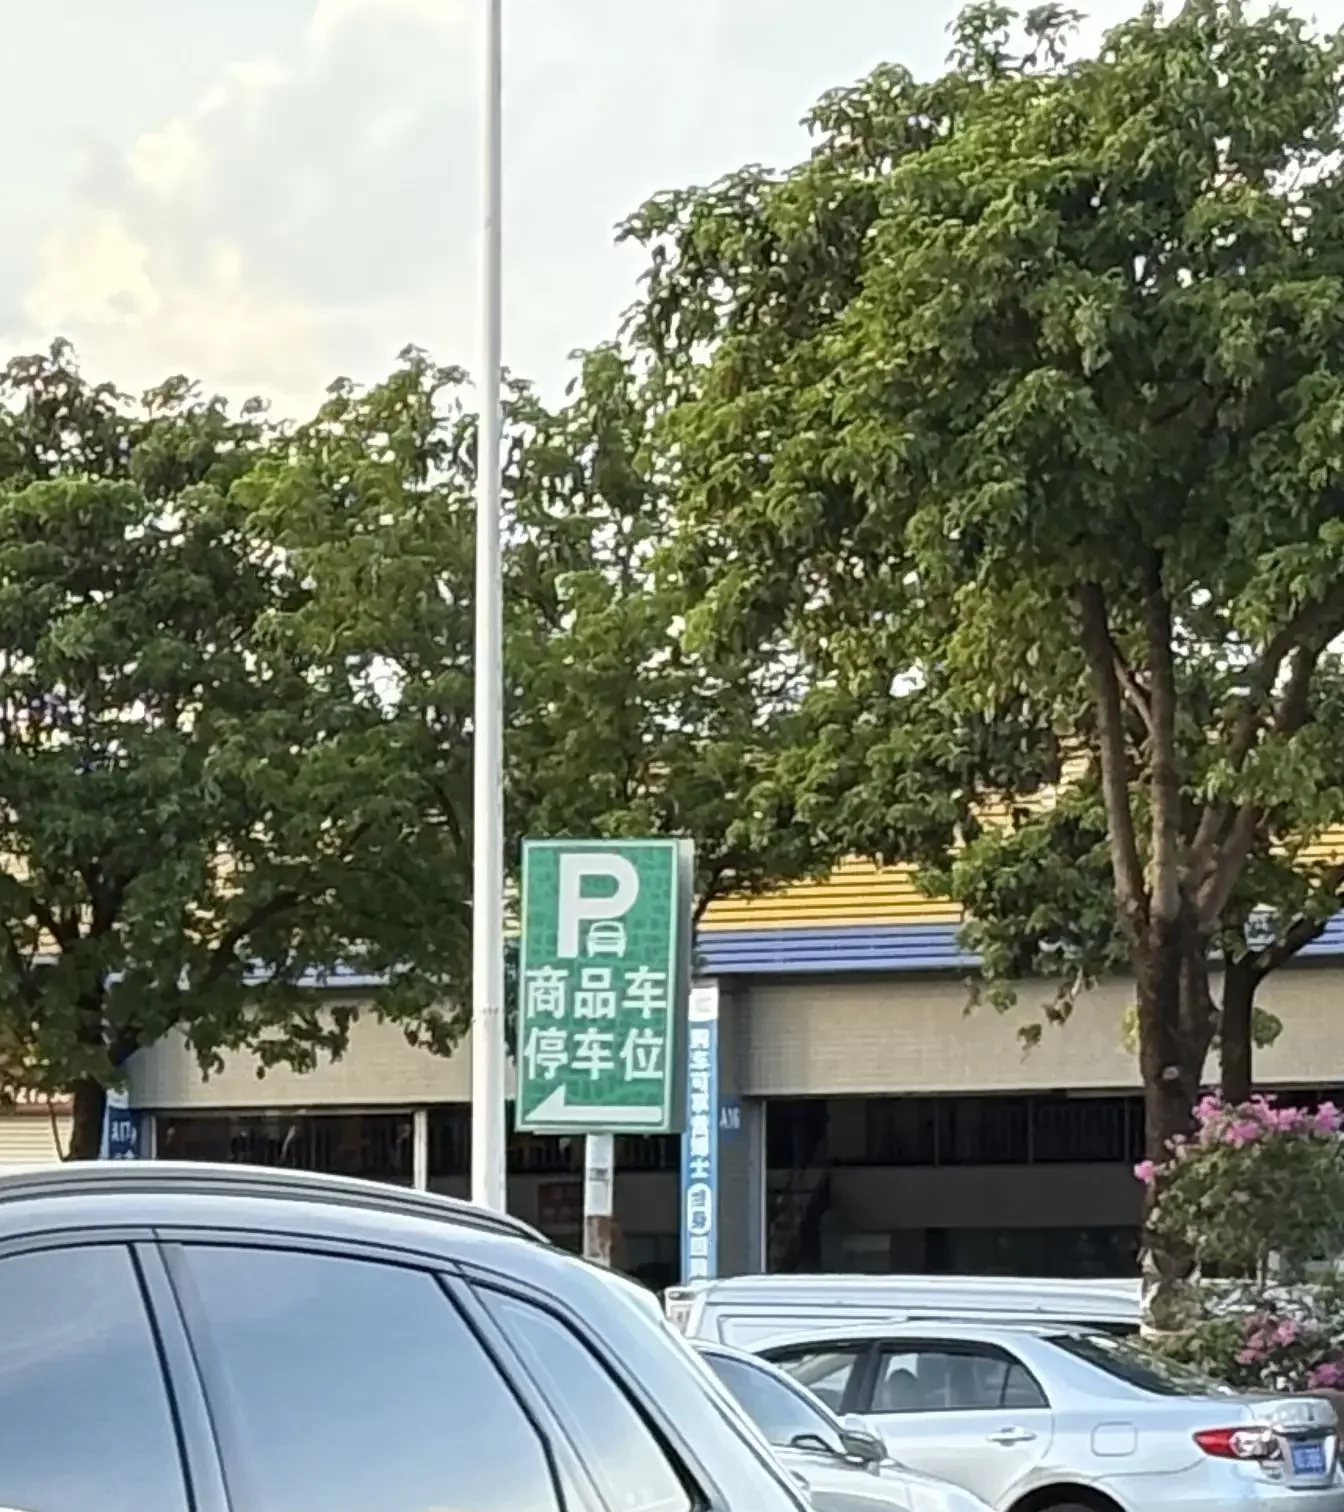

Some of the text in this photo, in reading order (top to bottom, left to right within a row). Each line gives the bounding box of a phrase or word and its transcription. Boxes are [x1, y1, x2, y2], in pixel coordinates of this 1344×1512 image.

[556, 853, 640, 959] P
[525, 965, 667, 1019] 商品车
[523, 1027, 664, 1081] 停车位
